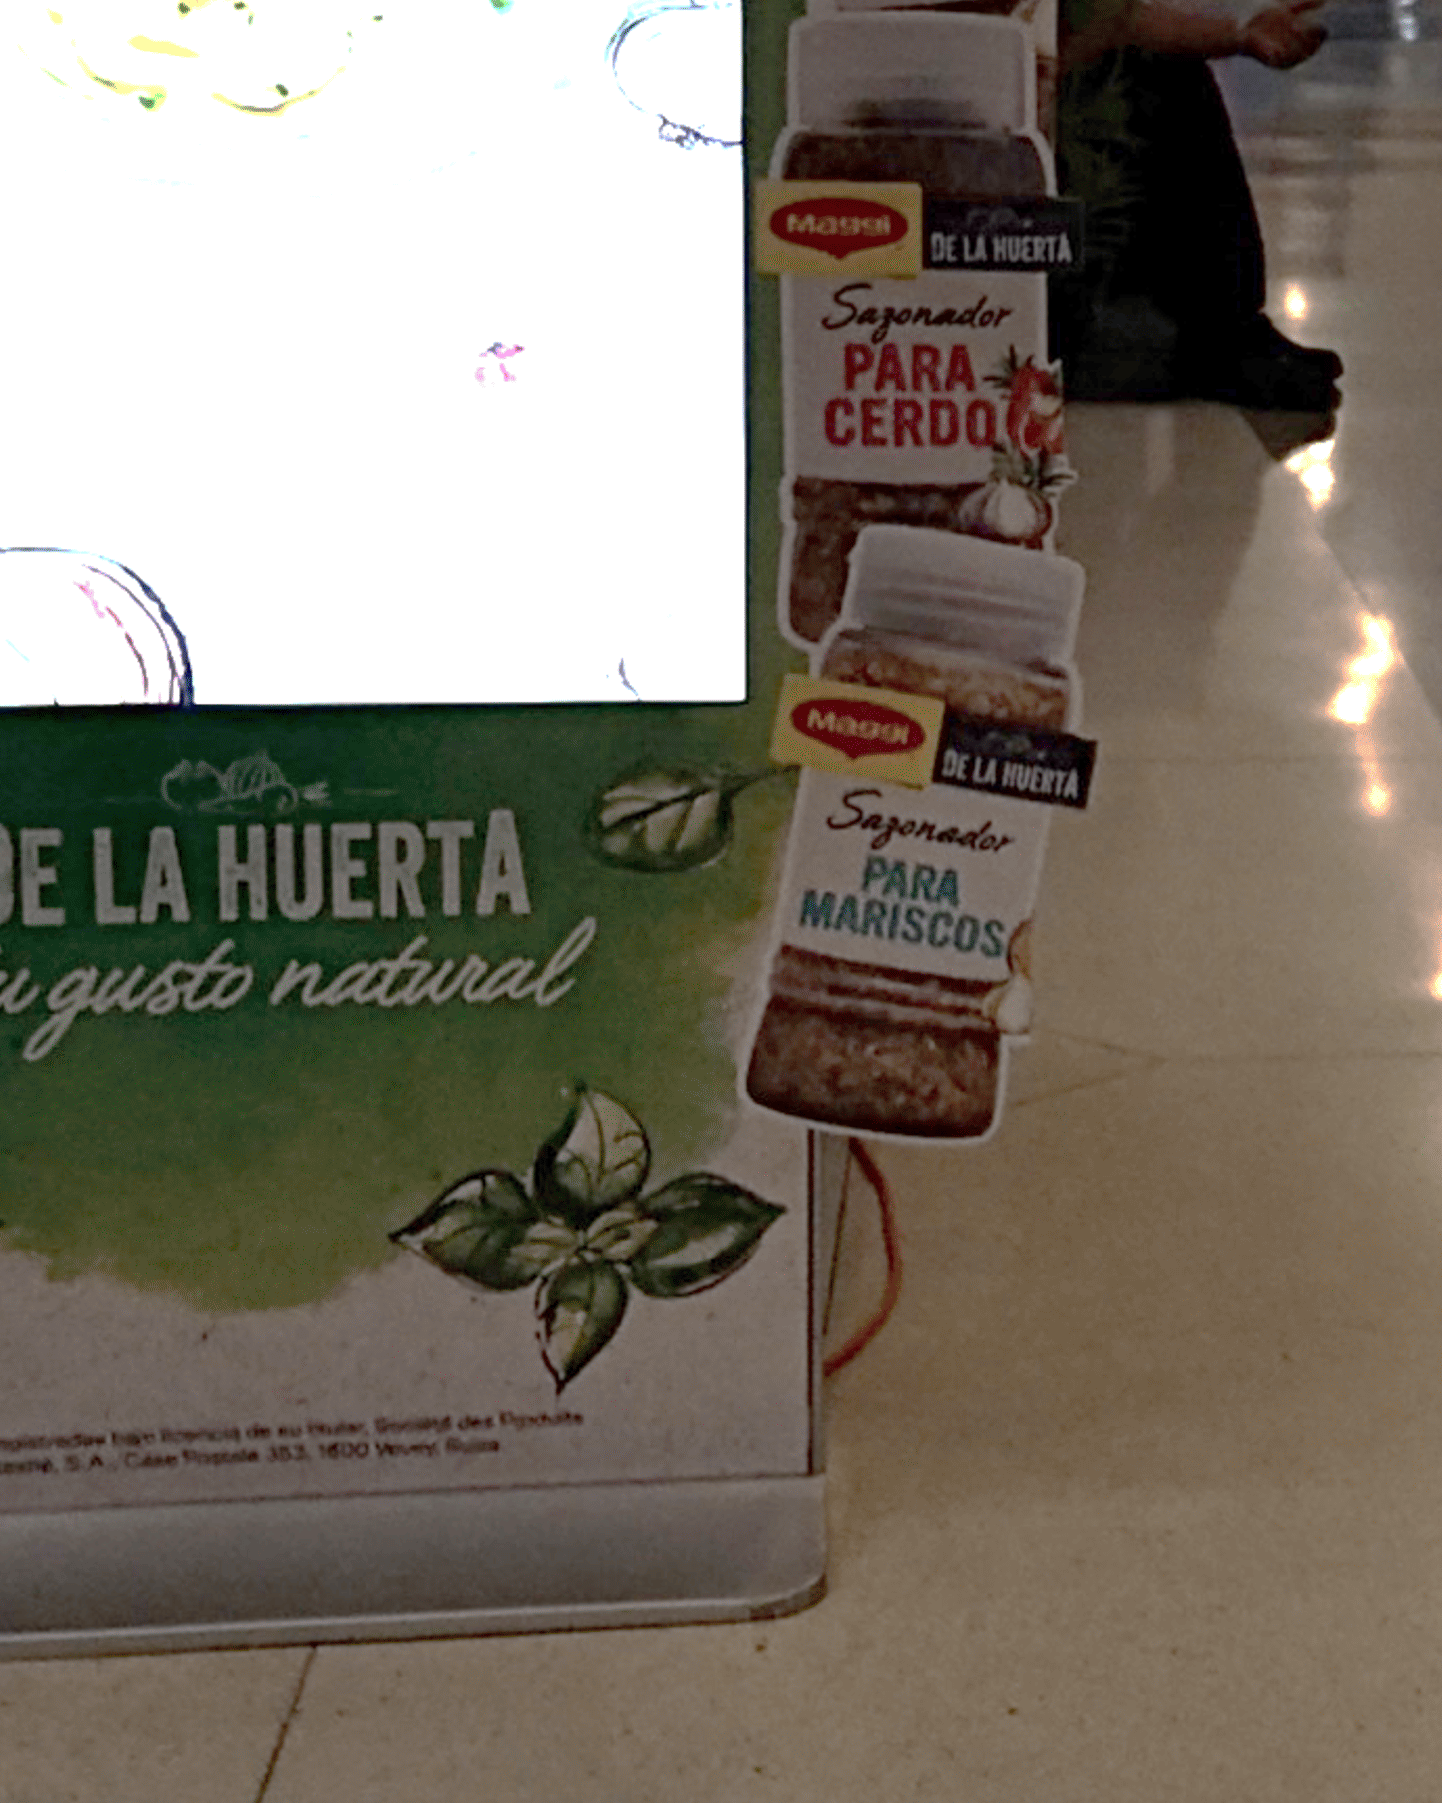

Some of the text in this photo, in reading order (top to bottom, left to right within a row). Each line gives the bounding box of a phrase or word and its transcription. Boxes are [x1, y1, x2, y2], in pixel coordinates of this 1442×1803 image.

[930, 232, 1073, 264] DE LA HUERTA
[822, 284, 1012, 343] Sazonador
[844, 344, 976, 392] PARA
[824, 399, 997, 447] CERDO
[806, 708, 910, 746] Maggi
[942, 752, 1080, 798] DE LA HUERTA
[827, 789, 1013, 852] Sazonador
[93, 826, 191, 926] LA
[218, 808, 532, 922] HUERTA
[863, 856, 960, 906] PARA
[800, 889, 1007, 958] MARISCOS
[22, 938, 256, 1061] gusto
[270, 916, 598, 1009] natural
